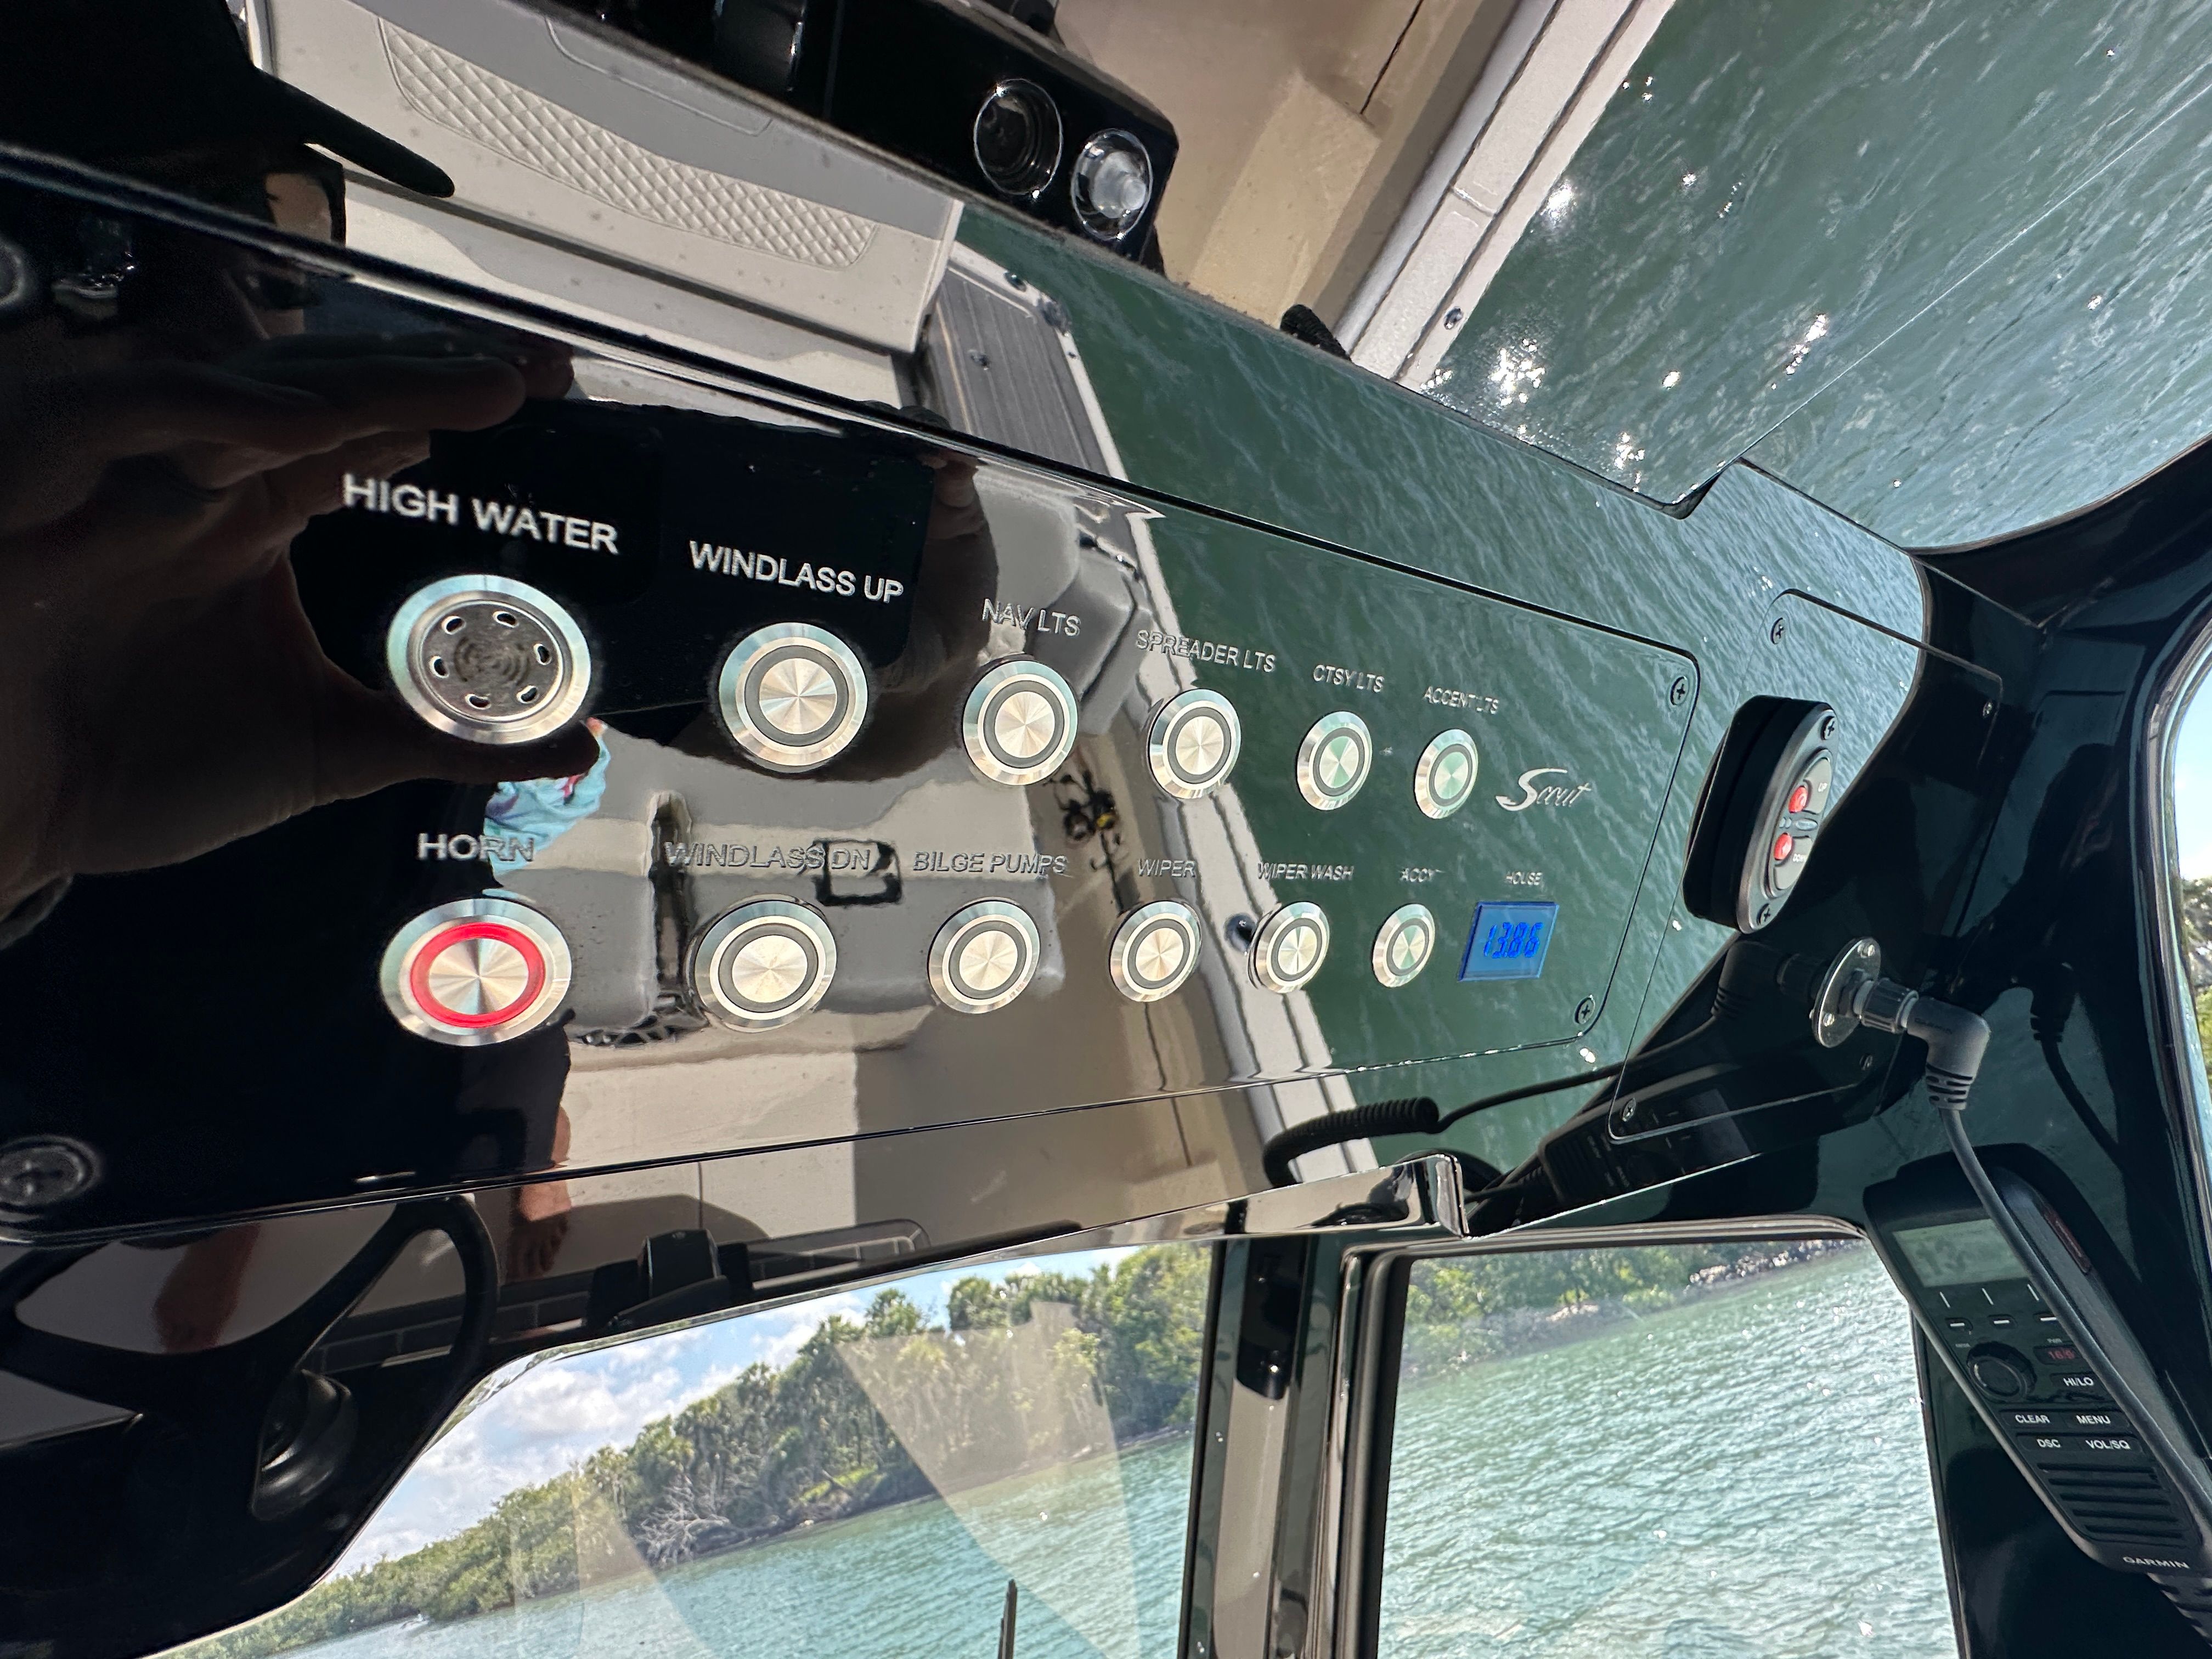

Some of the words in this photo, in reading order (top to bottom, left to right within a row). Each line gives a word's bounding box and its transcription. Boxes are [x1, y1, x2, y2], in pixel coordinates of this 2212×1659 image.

[342, 473, 458, 526] HIGH
[471, 498, 618, 554] WATER
[689, 540, 856, 597] WINDLASS
[863, 572, 904, 604] UP
[981, 597, 1034, 630] NAV
[1037, 609, 1081, 637] LTS
[1135, 629, 1239, 667] SPREADER
[1243, 650, 1276, 673] LTS
[1312, 664, 1353, 687] CTSY
[1356, 672, 1385, 693] LTS
[417, 832, 536, 863] HORN
[663, 842, 825, 870] WINDLASS
[831, 848, 871, 871] DN
[913, 851, 985, 873] BILGE
[989, 853, 1068, 874] PUMPS
[1137, 858, 1197, 878] WIPER
[1256, 862, 1307, 880] WIPER
[1310, 864, 1355, 881] WASH
[2063, 1376, 2095, 1387] HI/LO
[2015, 1414, 2051, 1424] CLEAR
[2075, 1414, 2111, 1425] MENU
[2036, 1438, 2062, 1448] DSC
[2085, 1439, 2131, 1450] VOL/SQ
[2122, 1556, 2191, 1570] GARMIN
